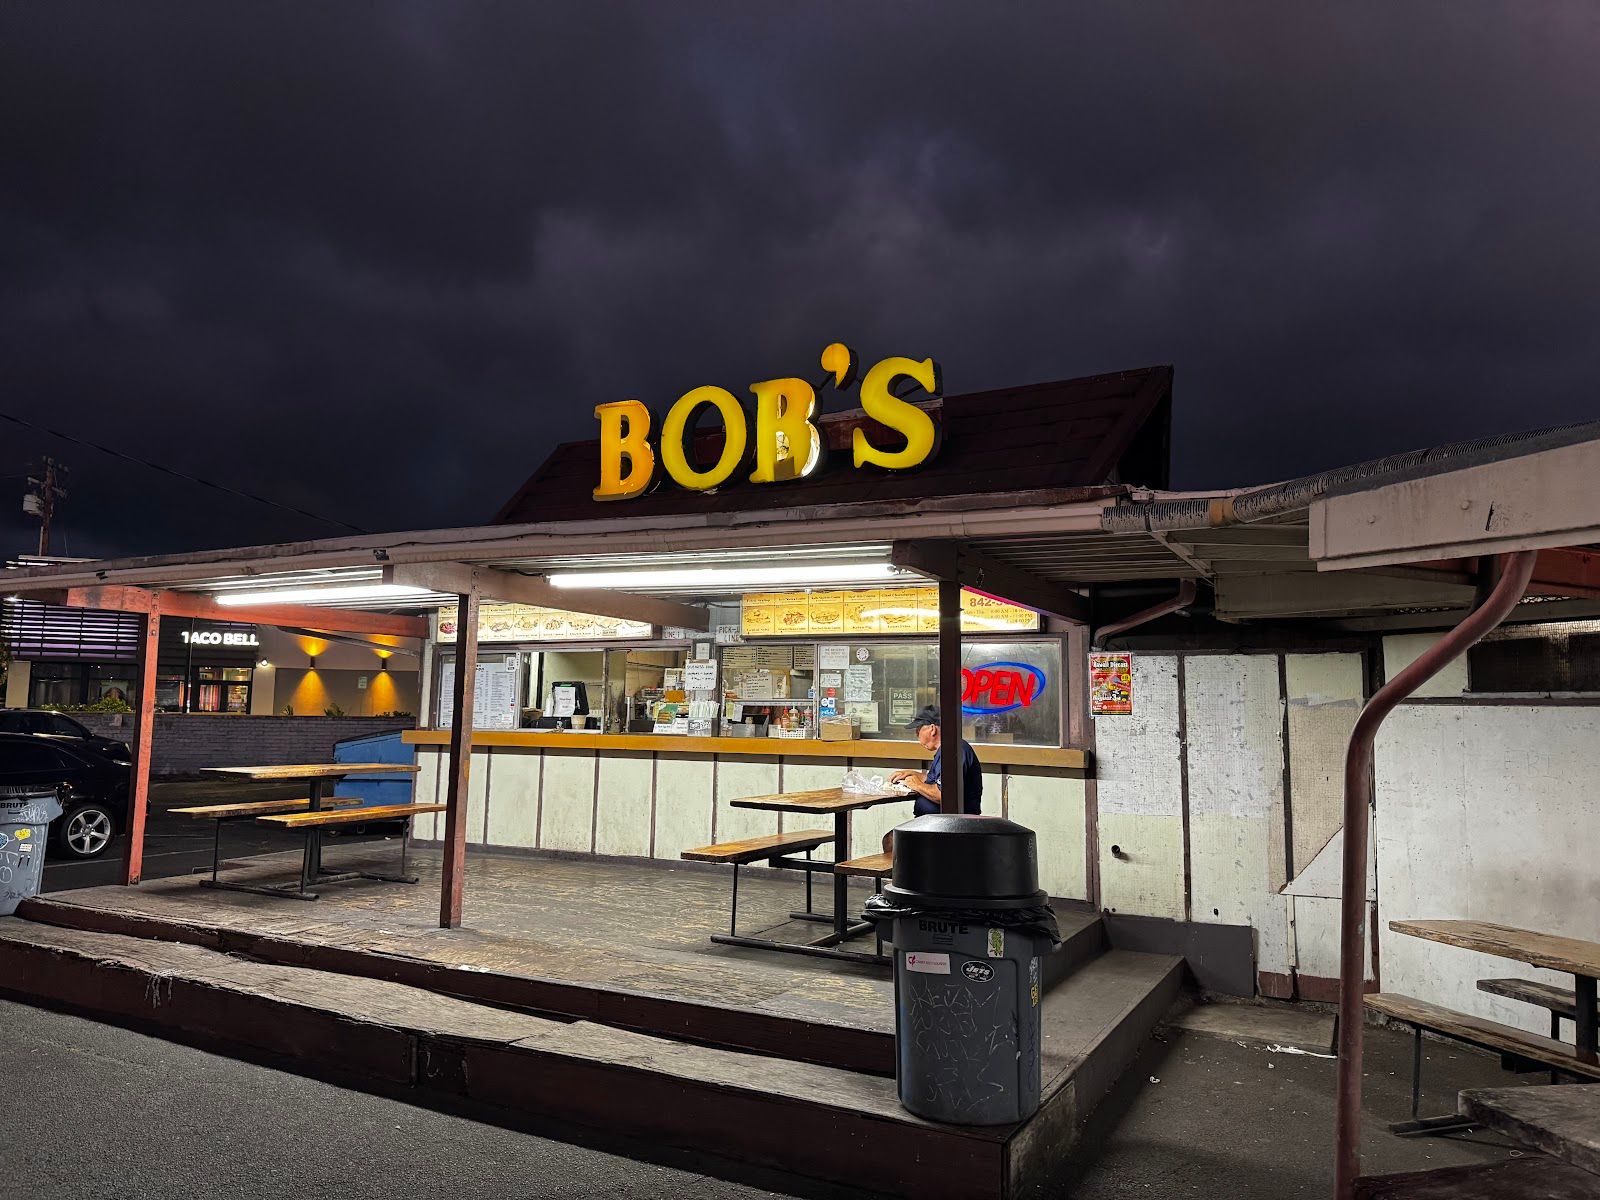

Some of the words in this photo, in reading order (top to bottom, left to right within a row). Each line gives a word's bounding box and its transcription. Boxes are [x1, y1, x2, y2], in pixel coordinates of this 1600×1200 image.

[593, 343, 937, 501] BOB'S
[970, 597, 1003, 607] 842-
[181, 631, 222, 645] TACO
[223, 632, 260, 646] BELL
[961, 669, 1036, 708] OPEN
[919, 919, 969, 934] BRUTE
